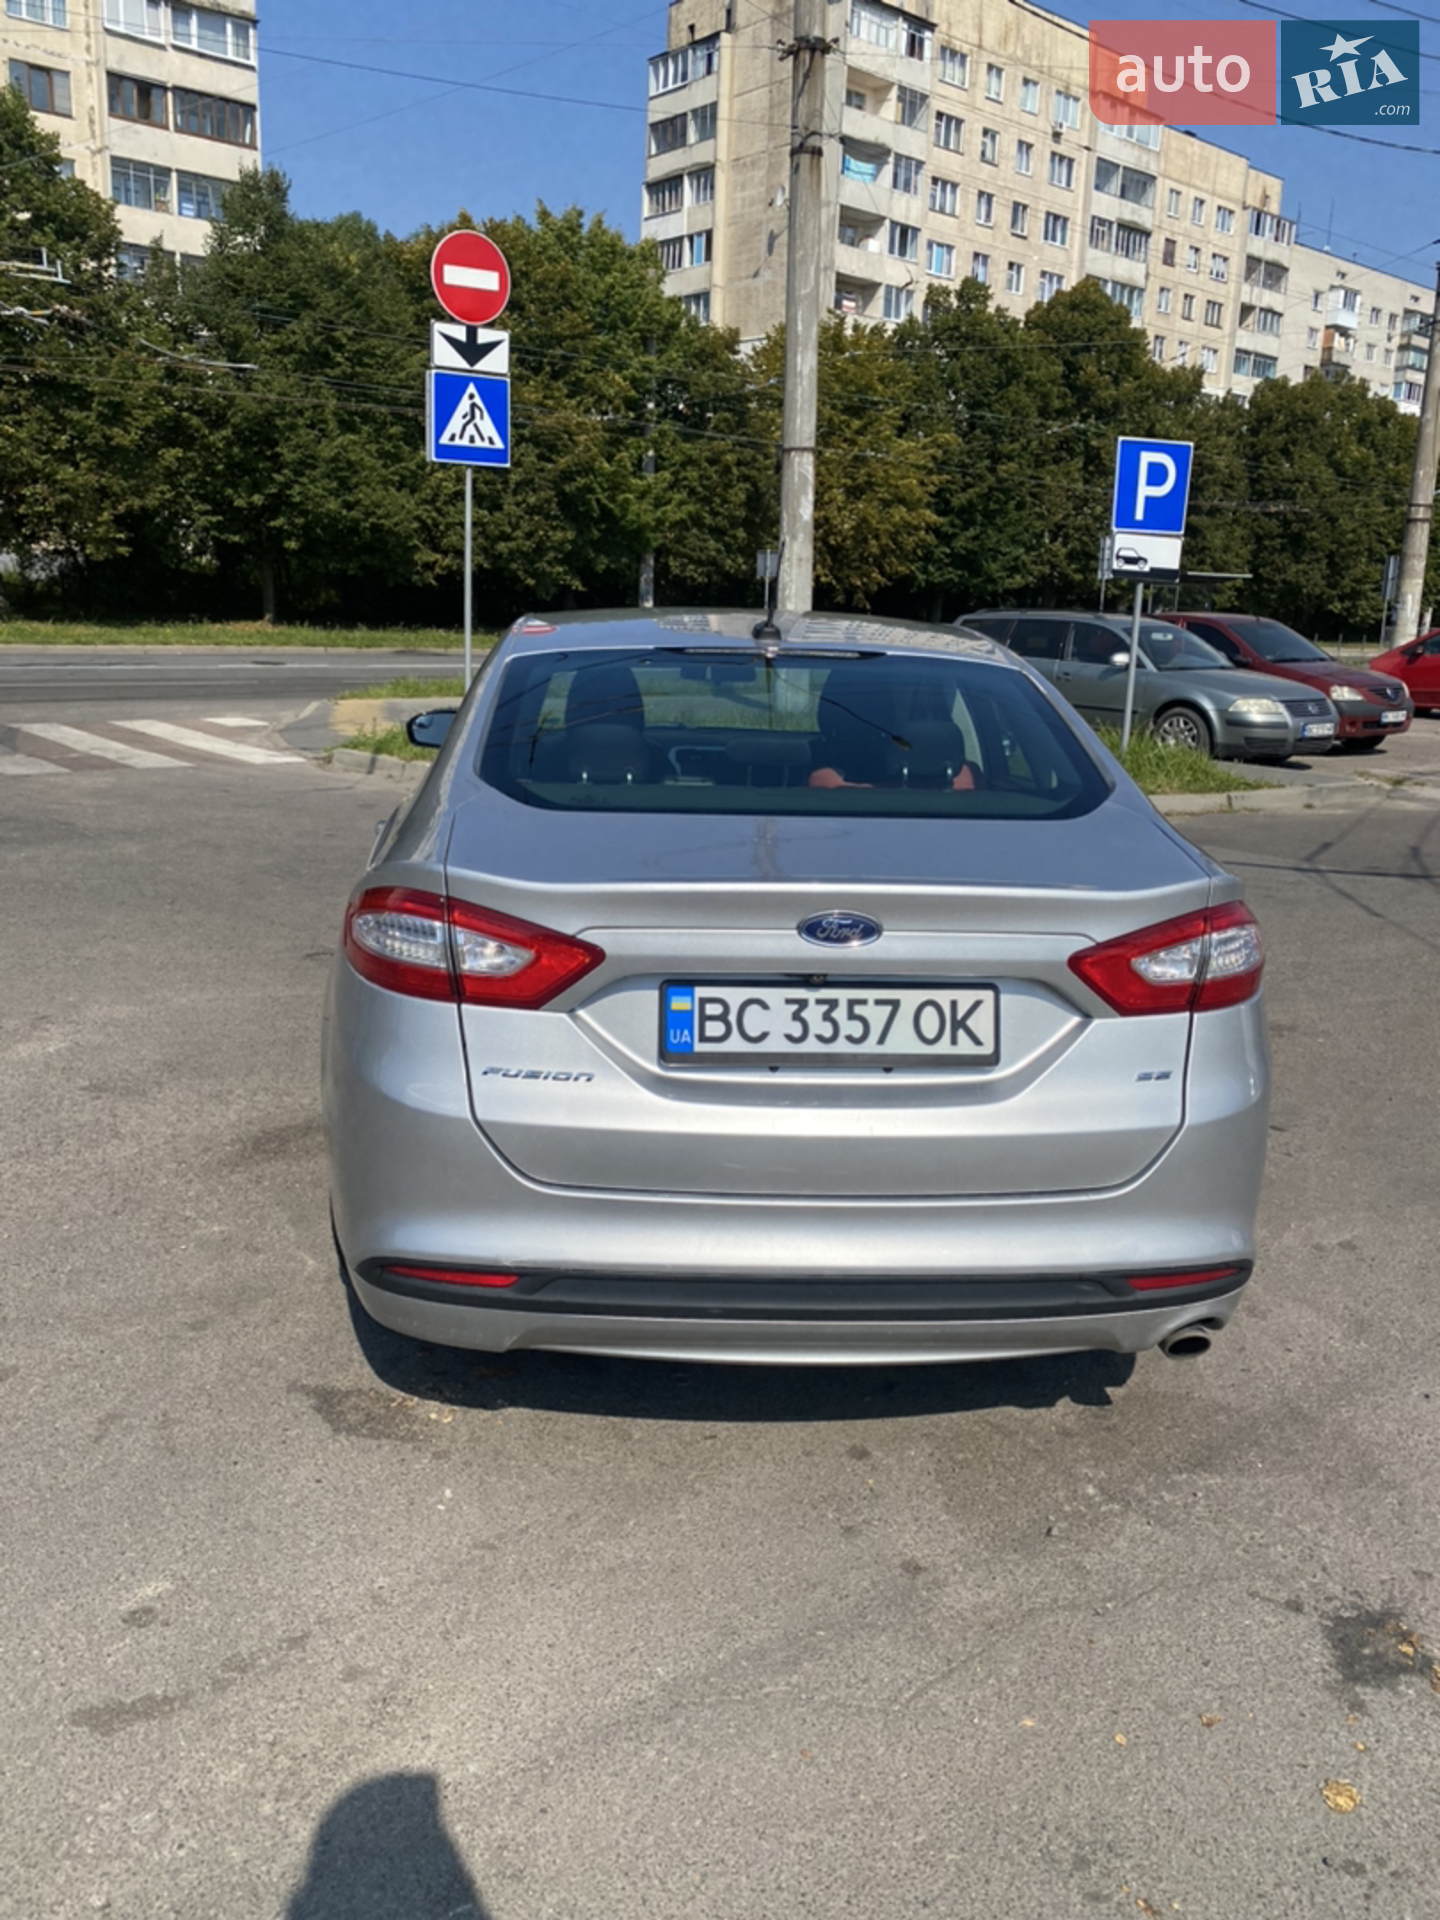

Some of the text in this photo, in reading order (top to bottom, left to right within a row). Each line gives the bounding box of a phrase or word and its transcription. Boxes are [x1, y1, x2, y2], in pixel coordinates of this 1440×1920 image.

[1134, 451, 1177, 521] P
[815, 917, 865, 939] Ford
[698, 996, 985, 1046] BC 3357 OK
[670, 1029, 692, 1044] UA
[481, 1066, 595, 1083] FUSION
